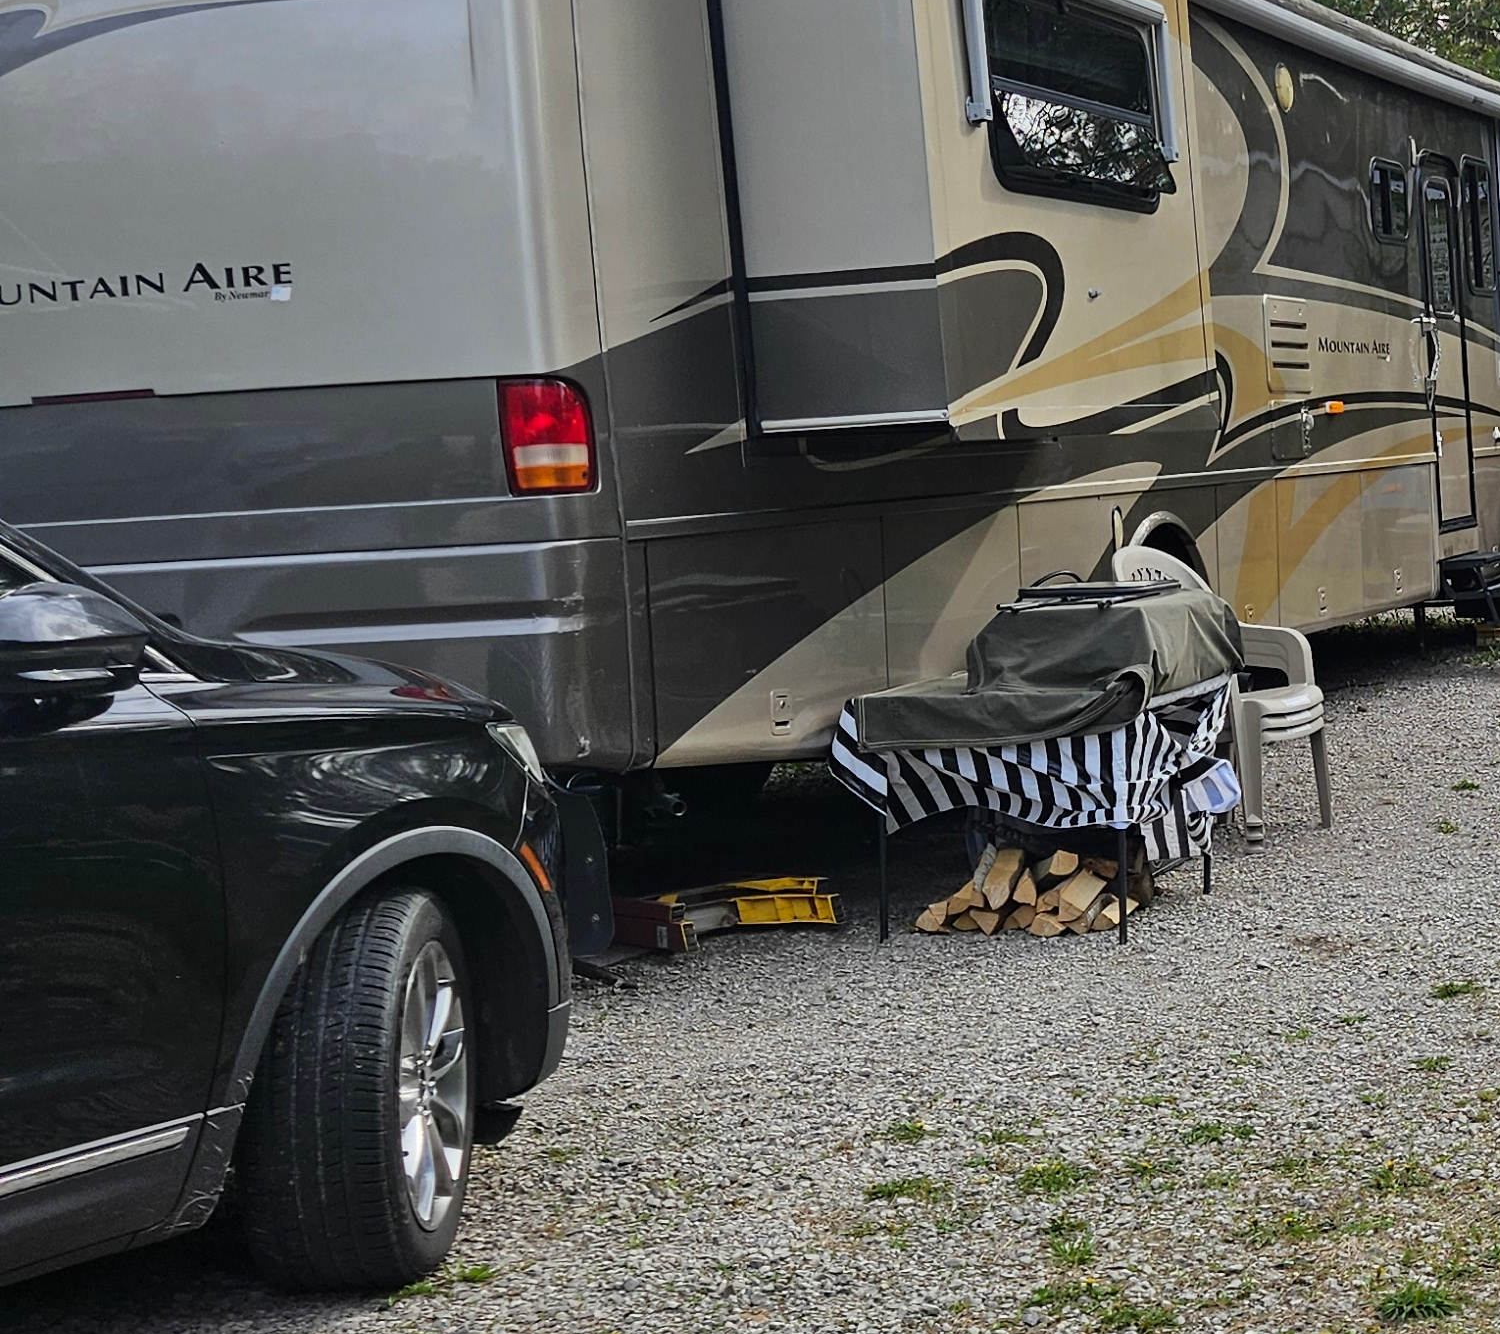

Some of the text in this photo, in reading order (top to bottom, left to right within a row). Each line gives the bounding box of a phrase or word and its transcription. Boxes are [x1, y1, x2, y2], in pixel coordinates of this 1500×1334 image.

[183, 262, 293, 292] AIRE
[214, 290, 270, 303] By Newmar
[1318, 337, 1390, 355] MOUNTAIN AIRE
